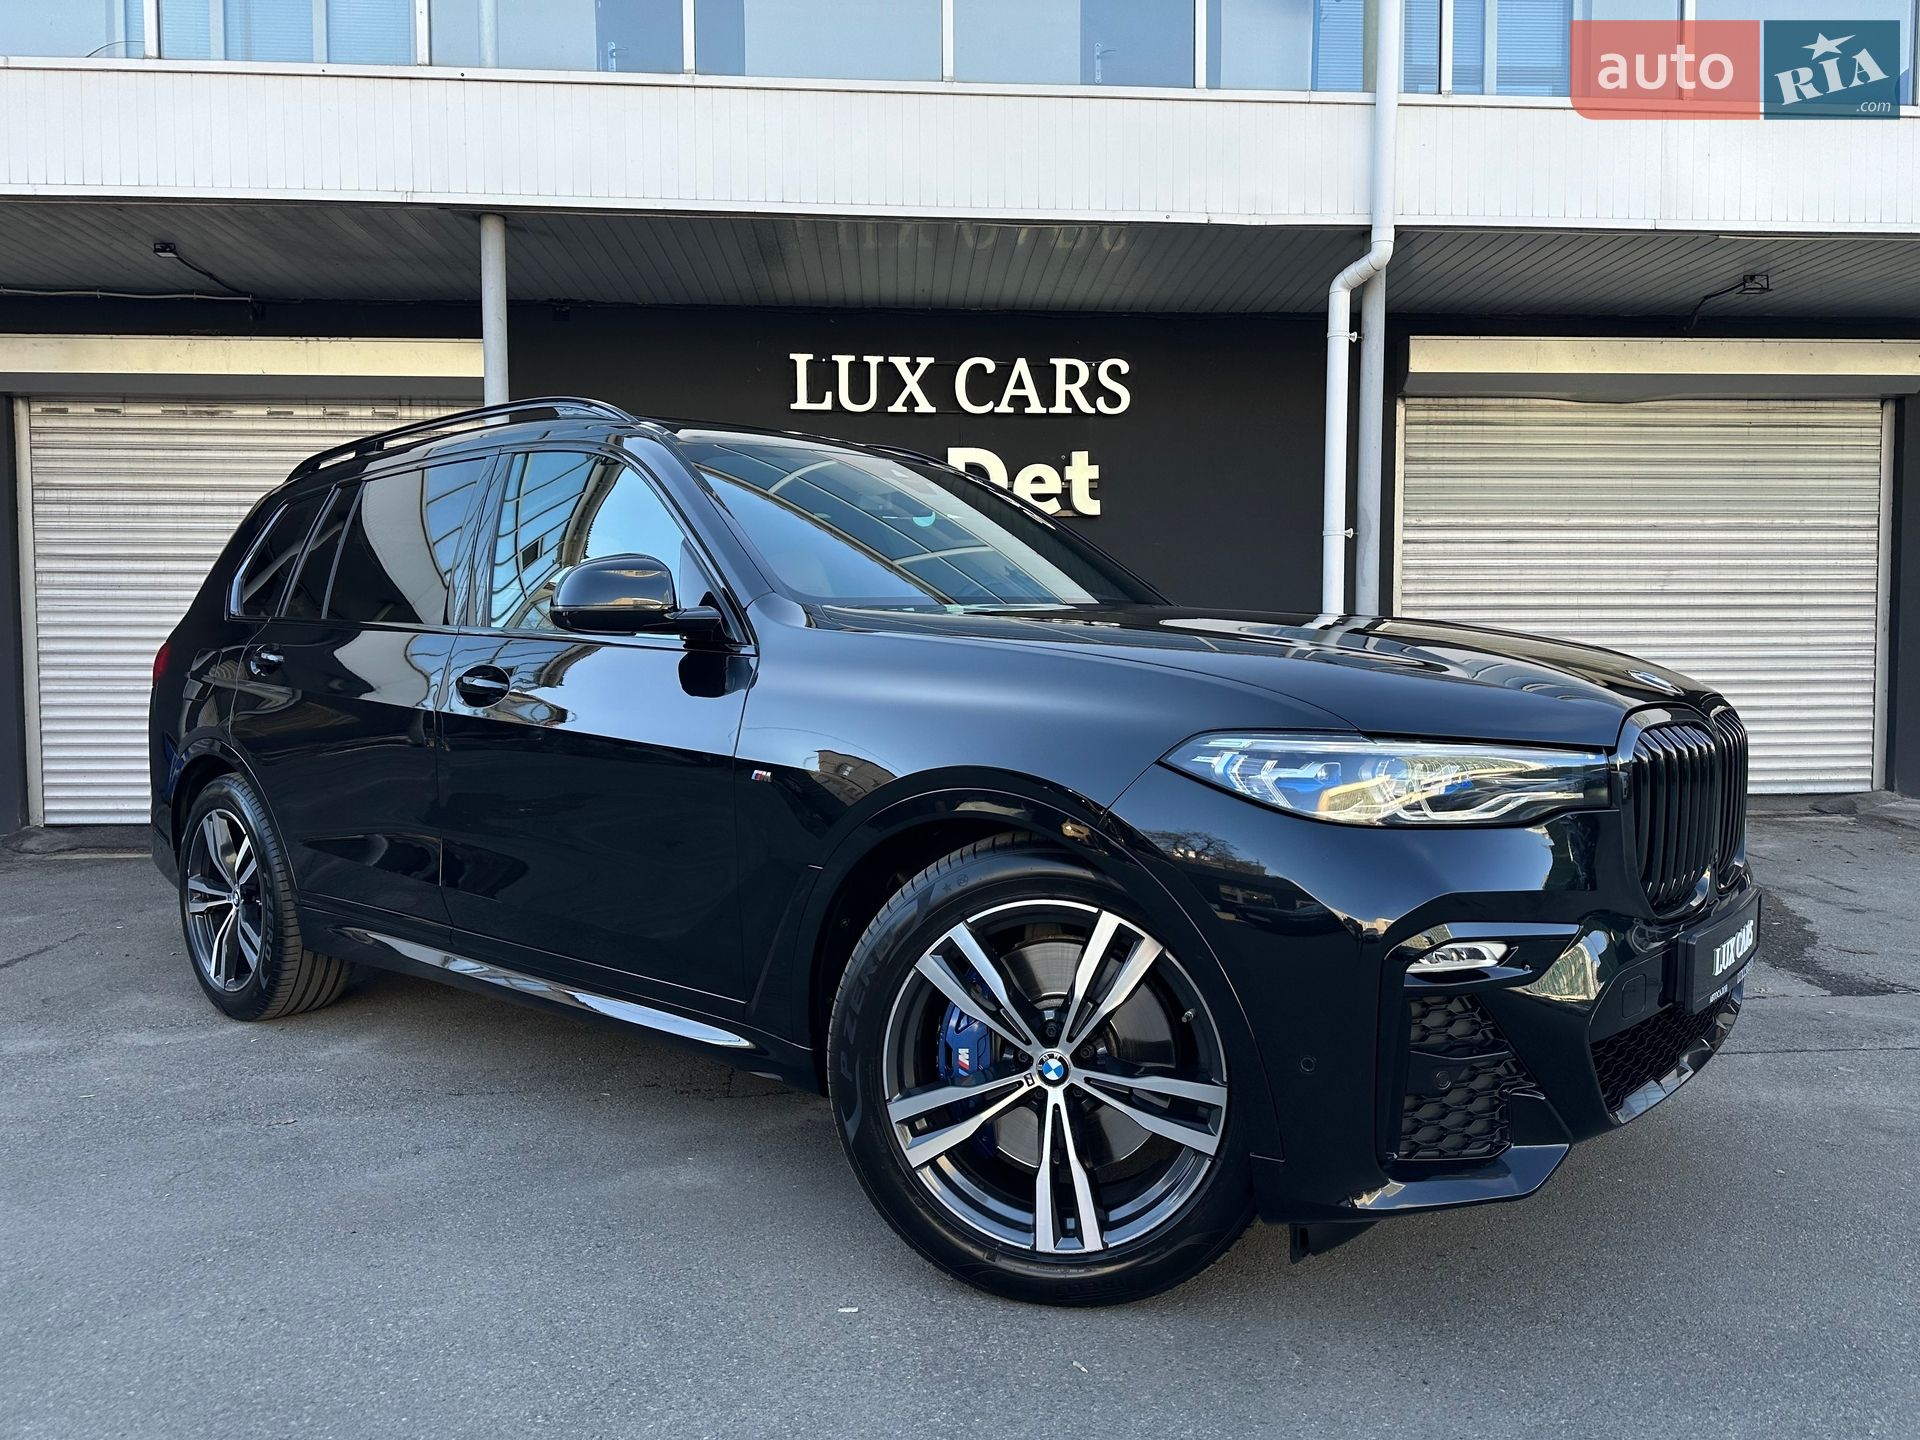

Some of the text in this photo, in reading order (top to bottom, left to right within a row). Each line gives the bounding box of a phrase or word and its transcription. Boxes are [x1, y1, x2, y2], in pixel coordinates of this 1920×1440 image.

[789, 353, 1131, 415] LUX CARS
[1713, 936, 1736, 975] LUX
